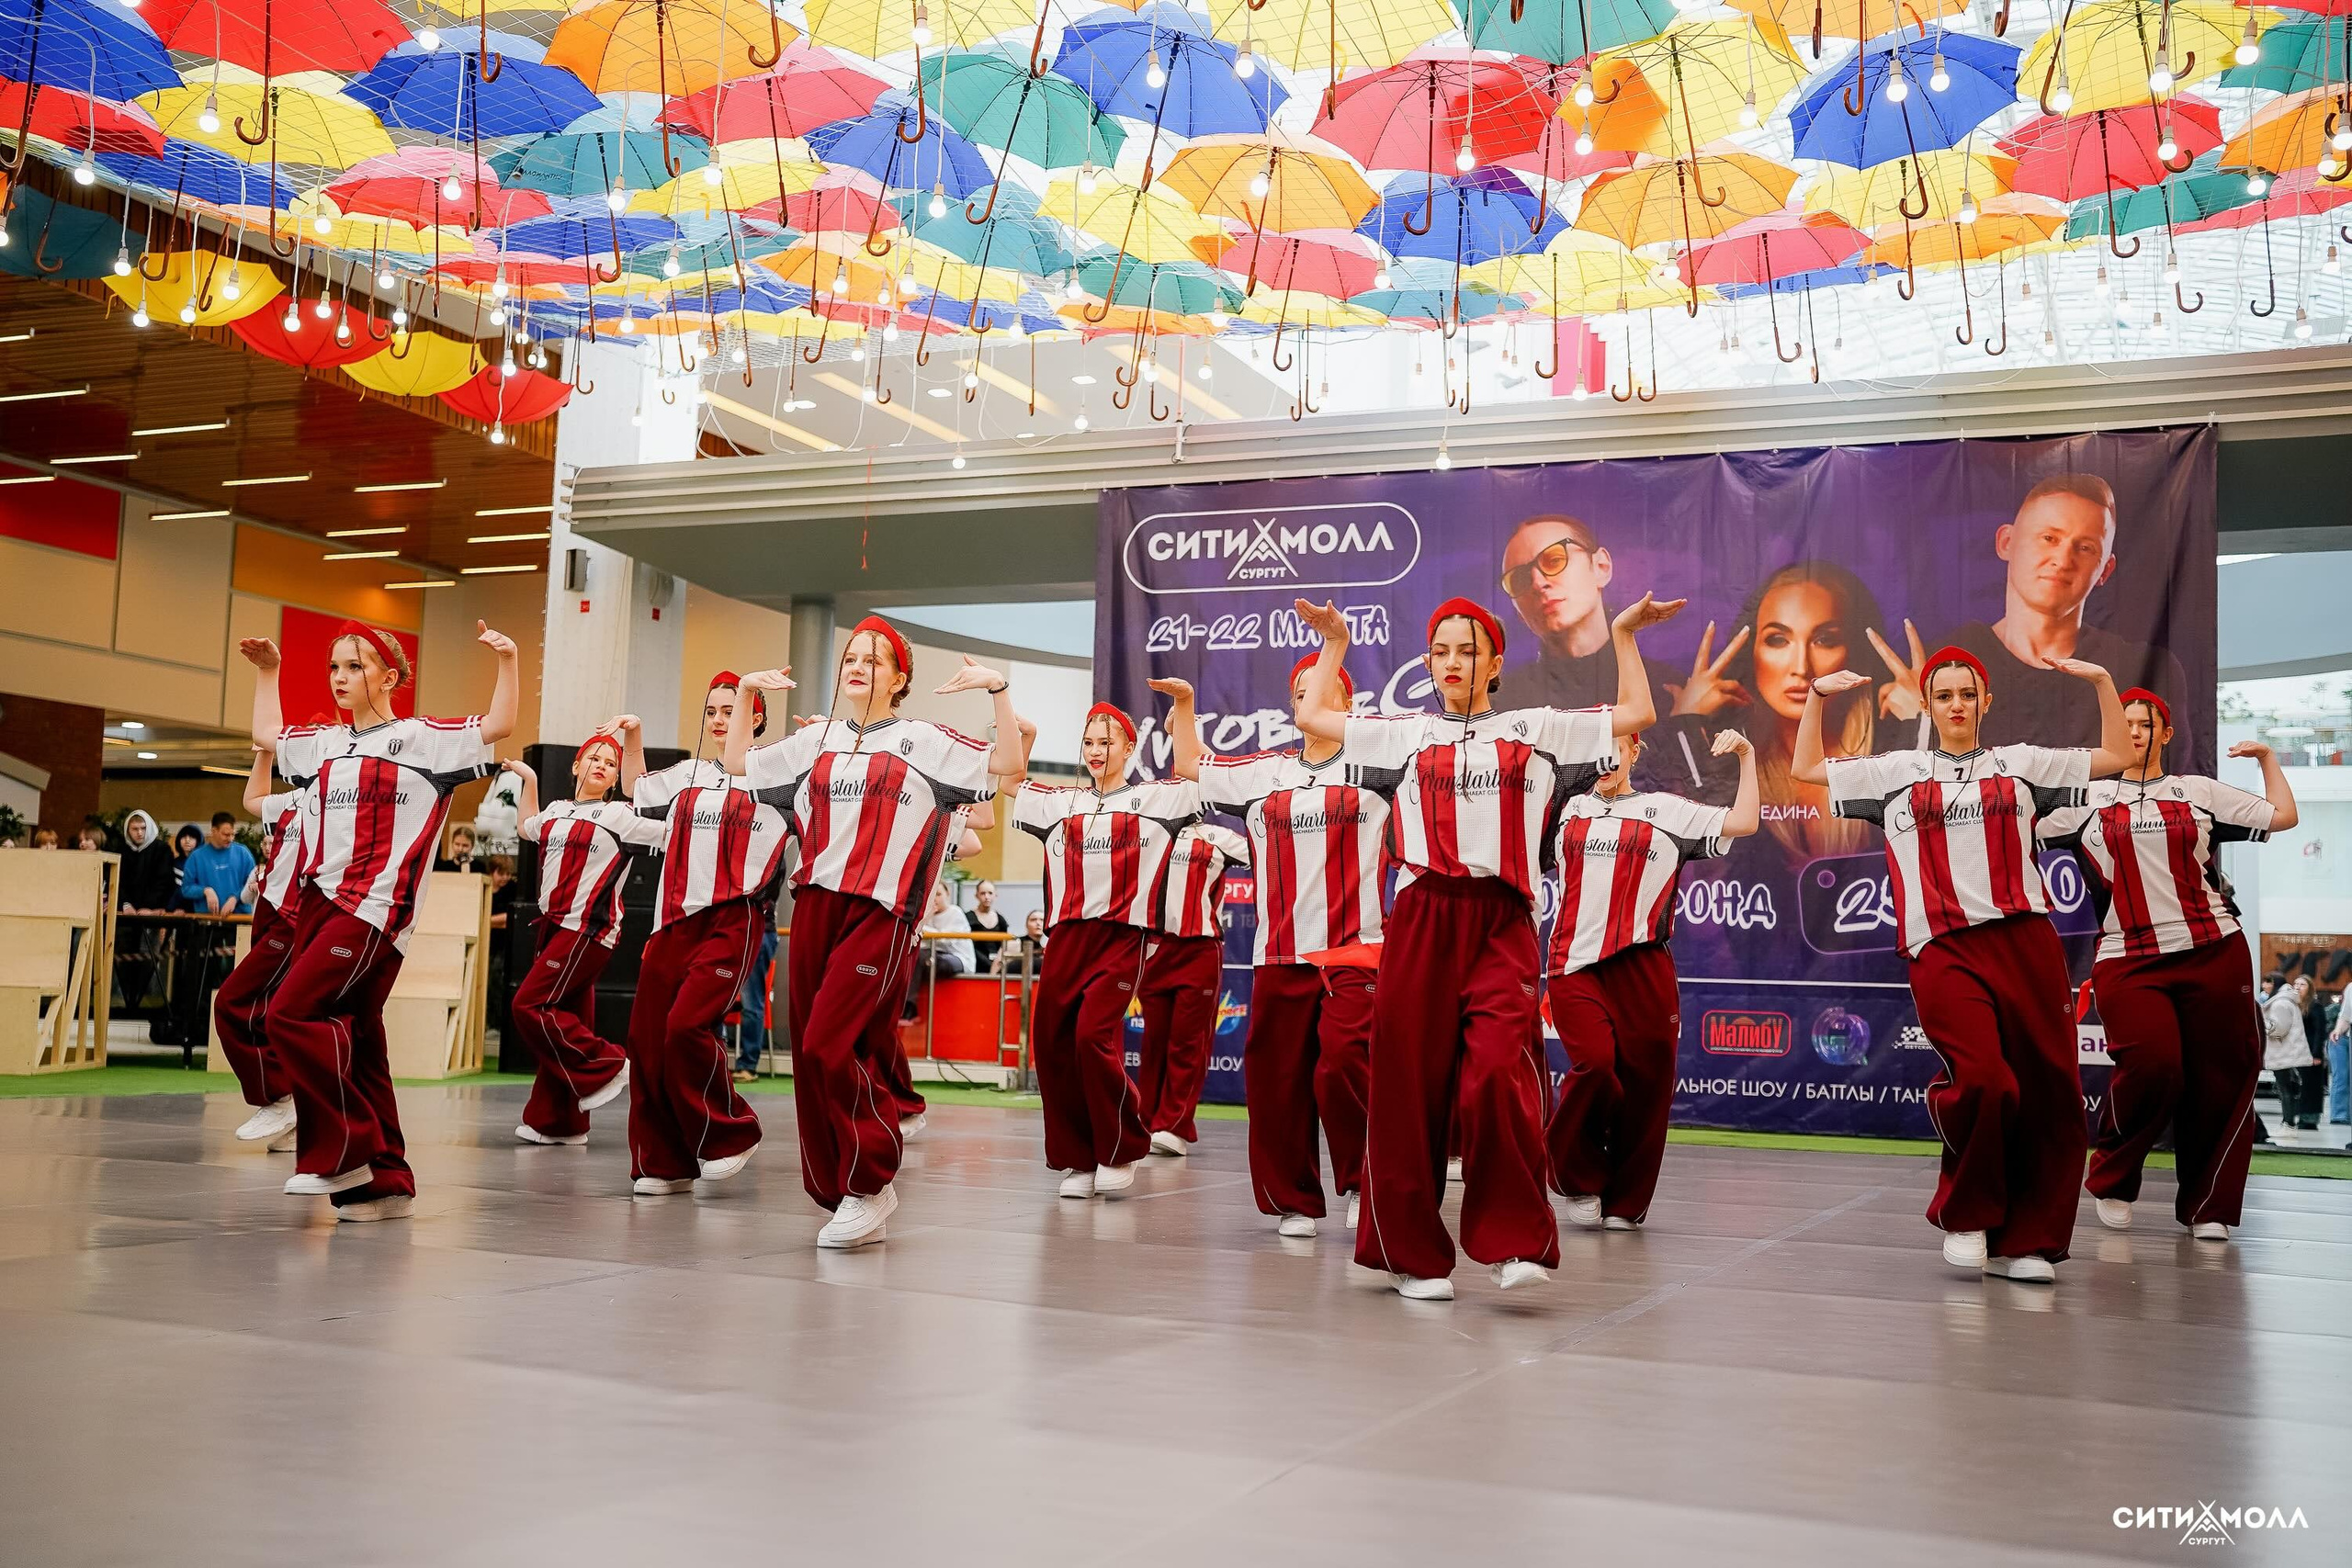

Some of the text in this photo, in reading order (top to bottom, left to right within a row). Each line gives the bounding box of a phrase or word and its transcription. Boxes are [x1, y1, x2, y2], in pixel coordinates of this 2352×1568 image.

[1148, 521, 1395, 561] СИТИ МОЛЛ
[1238, 566, 1287, 580] СУРГУТ
[1145, 604, 1390, 652] 21-22 МАТА
[346, 742, 357, 755] 7
[1307, 775, 1317, 786] 7
[1953, 767, 1964, 781] 7
[717, 778, 725, 788] 7
[568, 809, 575, 818] 7
[1603, 807, 1612, 816] 7
[1760, 805, 1821, 821] ЕДИНА
[1181, 829, 1187, 839] 7
[1224, 883, 1254, 899] РГУ
[1675, 1078, 1737, 1096] ЛЬНОЕ
[1742, 1080, 1788, 1098] ШОУ
[1805, 1082, 1874, 1102] БАТТЛЫ
[1892, 1087, 1928, 1104] ТАН
